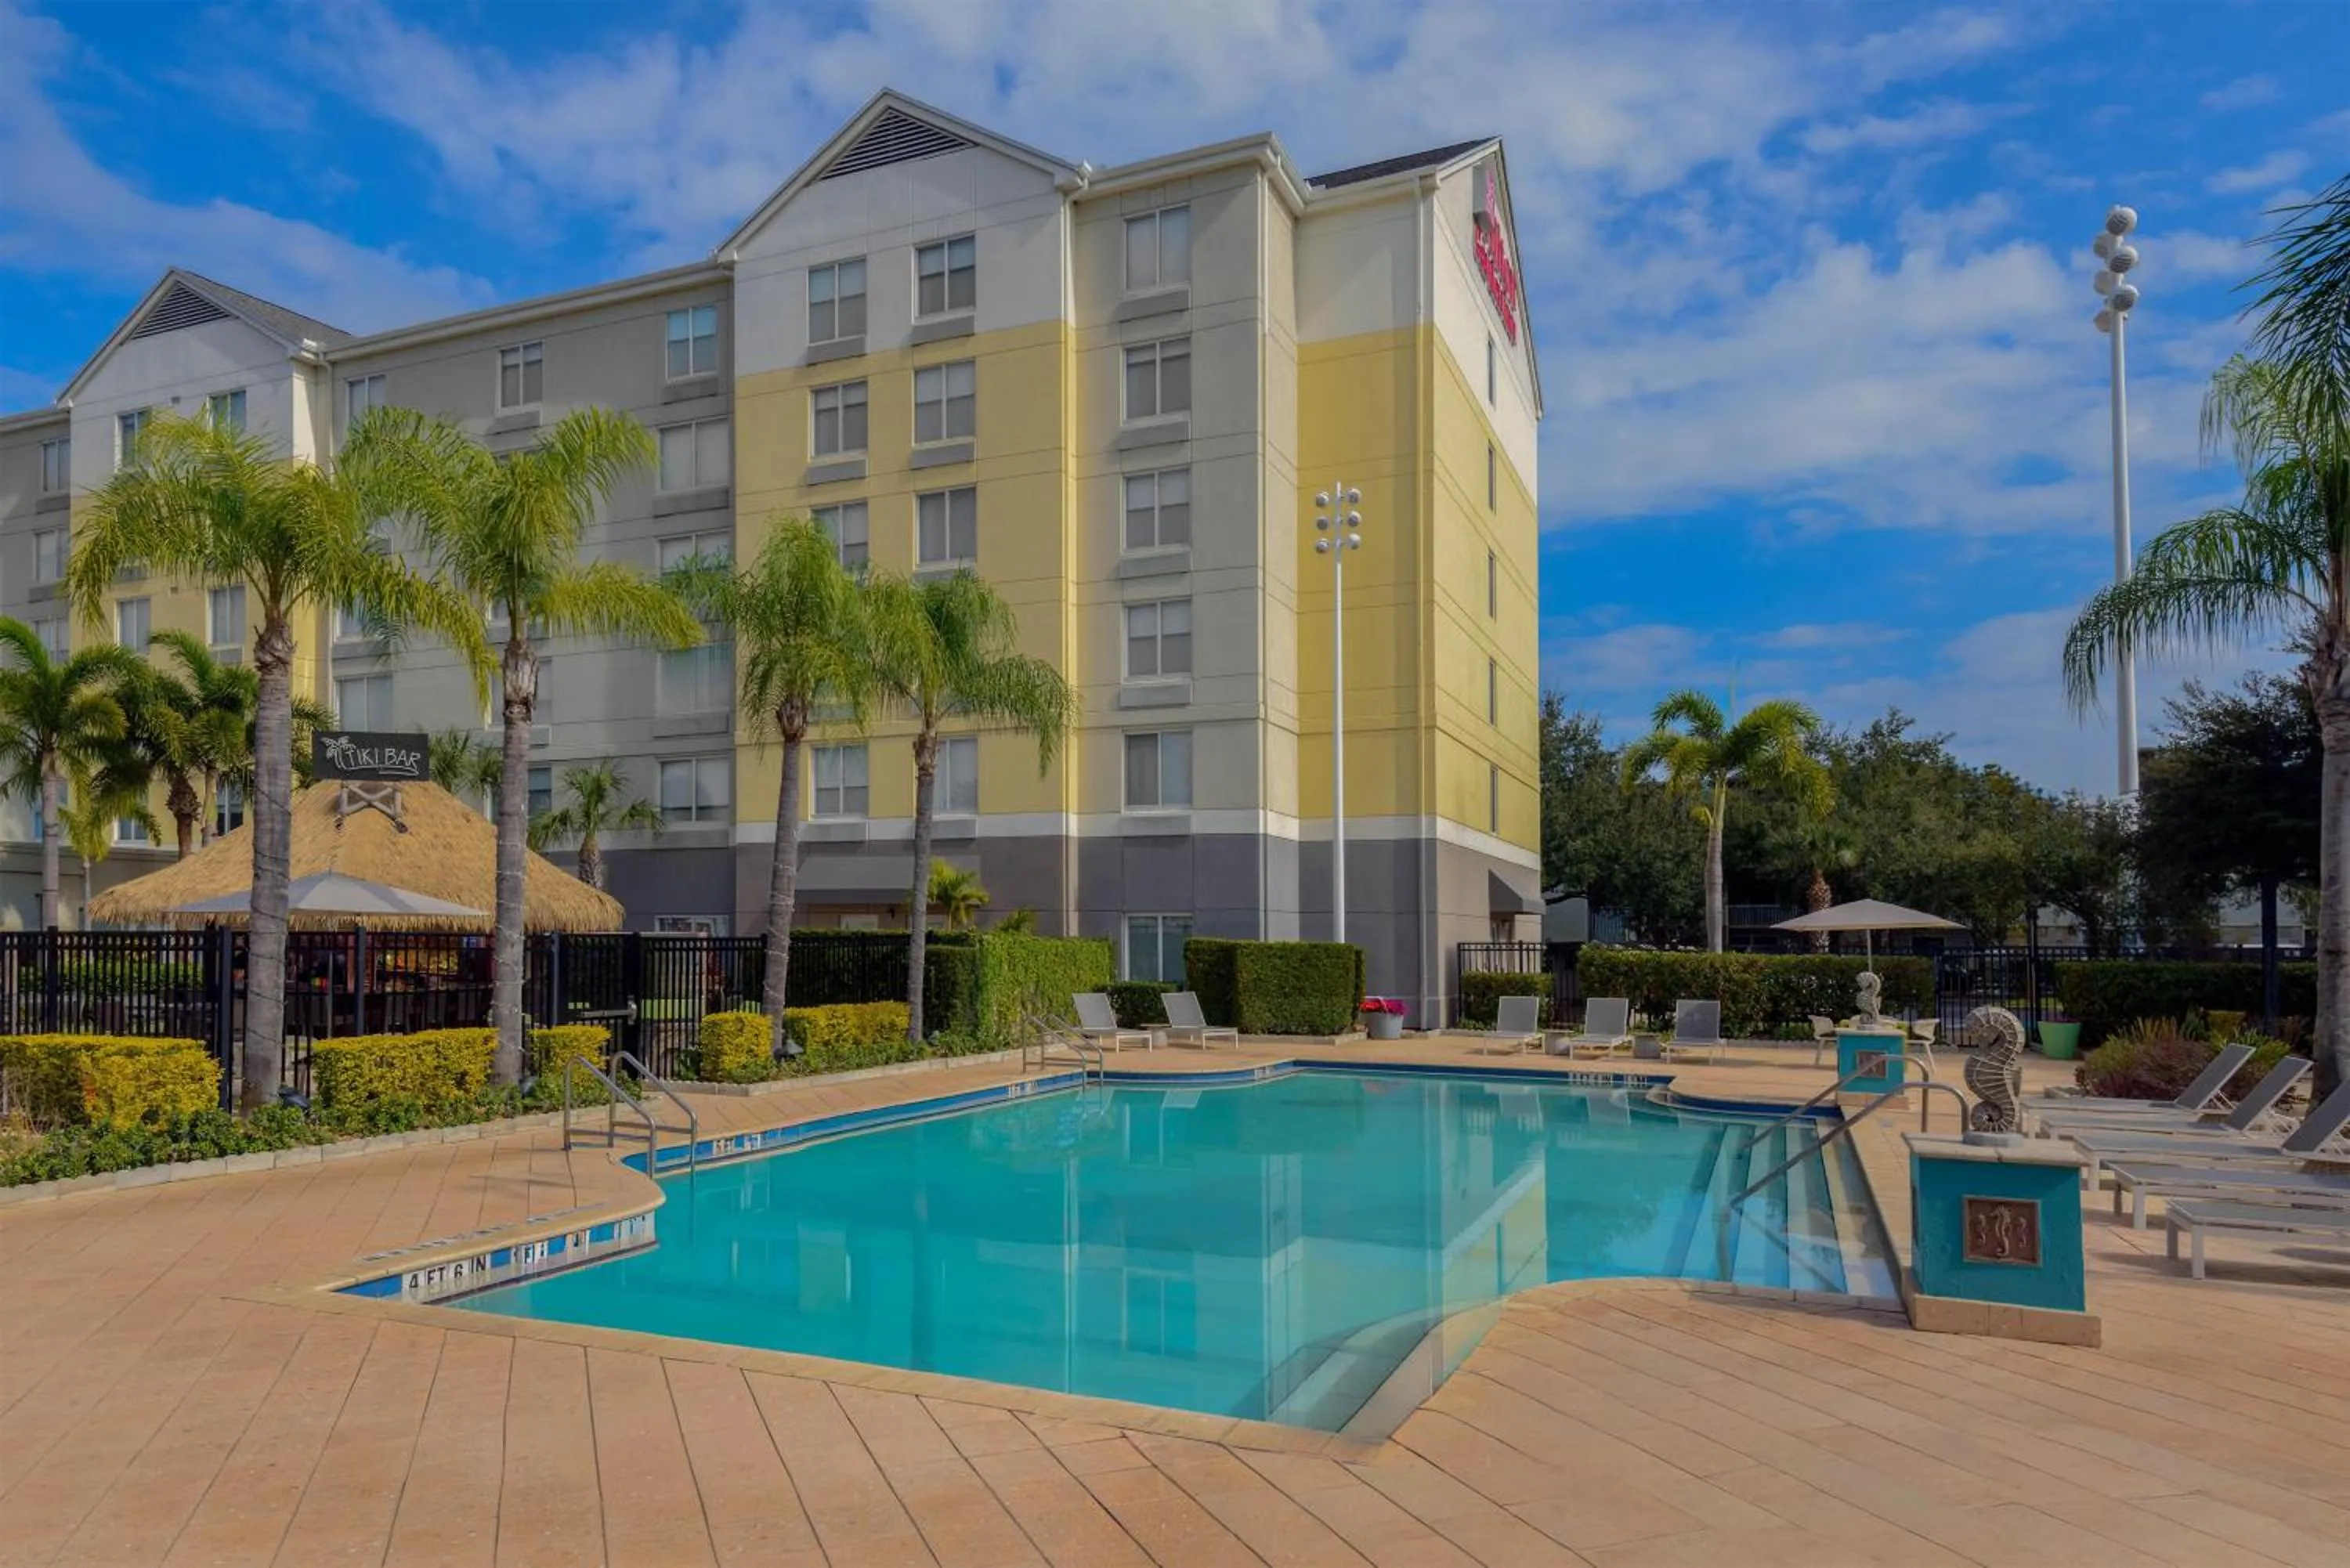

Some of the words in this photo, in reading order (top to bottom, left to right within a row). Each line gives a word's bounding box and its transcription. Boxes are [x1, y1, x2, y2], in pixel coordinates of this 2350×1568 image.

[345, 747, 379, 766] TIKI
[385, 748, 421, 770] BAR
[427, 1266, 446, 1285] FT
[471, 1254, 486, 1274] IN
